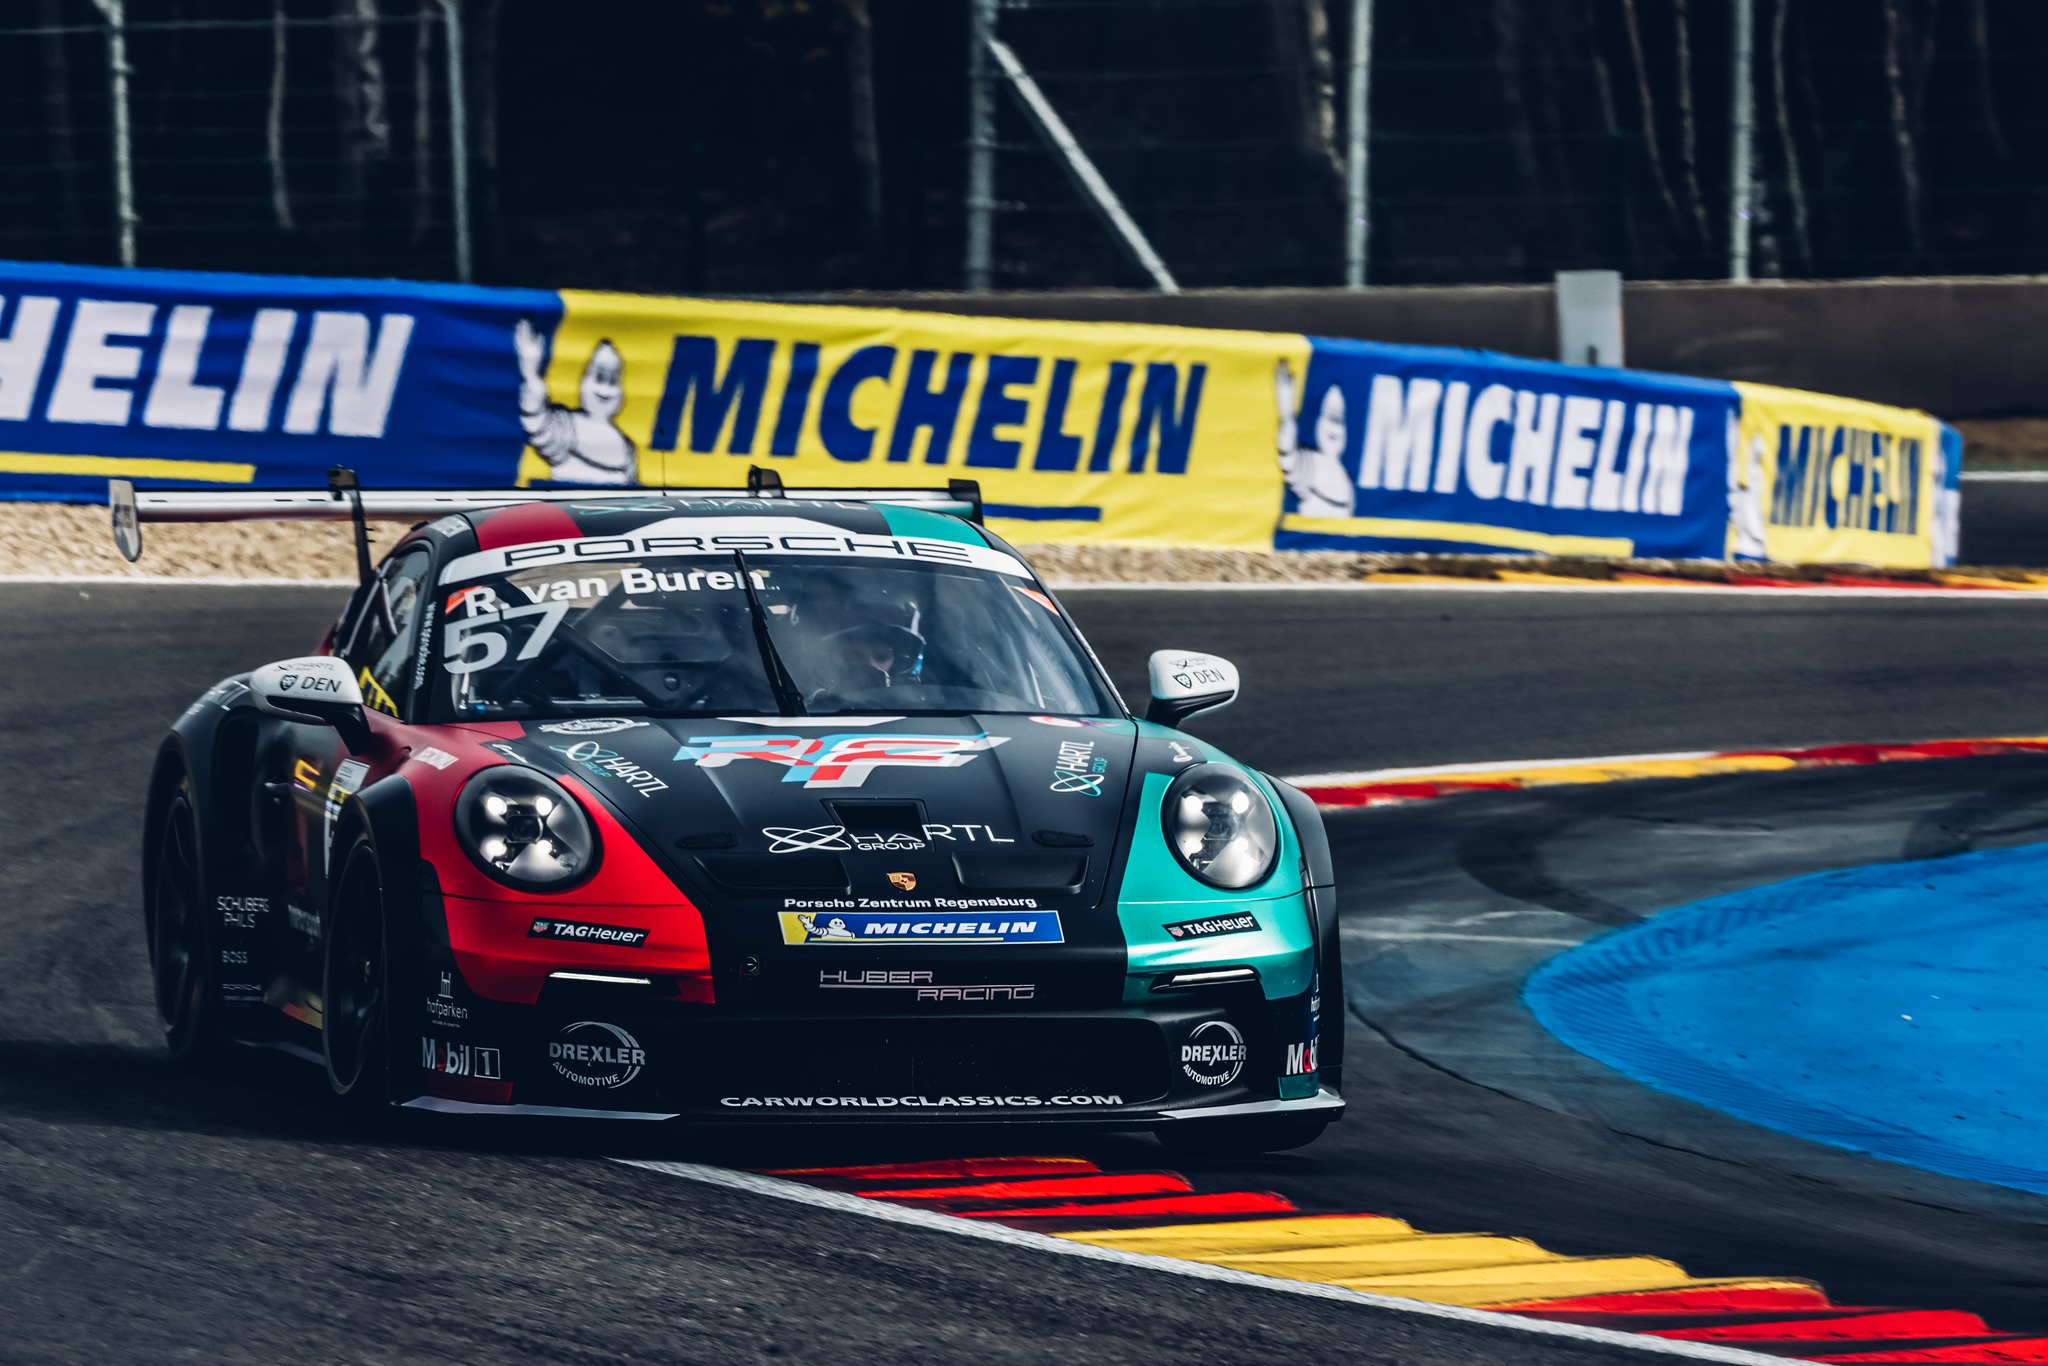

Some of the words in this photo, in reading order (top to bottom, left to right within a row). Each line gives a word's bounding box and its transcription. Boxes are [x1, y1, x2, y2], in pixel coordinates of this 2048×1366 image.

[650, 334, 1207, 474] MICHELIN
[1357, 374, 1695, 516] MICHELIN
[1769, 423, 1921, 535] MICHELIN
[503, 535, 972, 566] PORSCHE
[464, 587, 510, 617] R.
[520, 577, 608, 604] van
[620, 567, 766, 595] Buren
[443, 599, 570, 674] 57
[301, 676, 342, 693] DEN
[1193, 669, 1226, 684] DEN
[1056, 741, 1095, 773] HARTL
[595, 757, 669, 798] HARTL
[850, 824, 1015, 843] HARTL
[857, 842, 926, 851] GROUP
[784, 898, 854, 908] Porsche
[858, 898, 932, 908] Zentrum
[934, 897, 1038, 909] Regensburg
[863, 921, 1037, 935] MICHELIN
[222, 950, 248, 964] BOSS
[819, 970, 934, 983] HUBER
[917, 986, 1035, 1001] RACING
[427, 997, 468, 1019] hofparken
[422, 1037, 470, 1076] Mobil
[481, 1050, 491, 1076] 1
[549, 1042, 646, 1067] DREXLER
[1181, 1045, 1247, 1066] DREXLER
[1286, 1034, 1320, 1076] Mobi
[552, 1061, 620, 1087] AUTOMOTIVE
[1183, 1064, 1230, 1085] AUTOMOTIVE
[720, 1095, 1123, 1107] CARWORLDCLASSICS.COM
